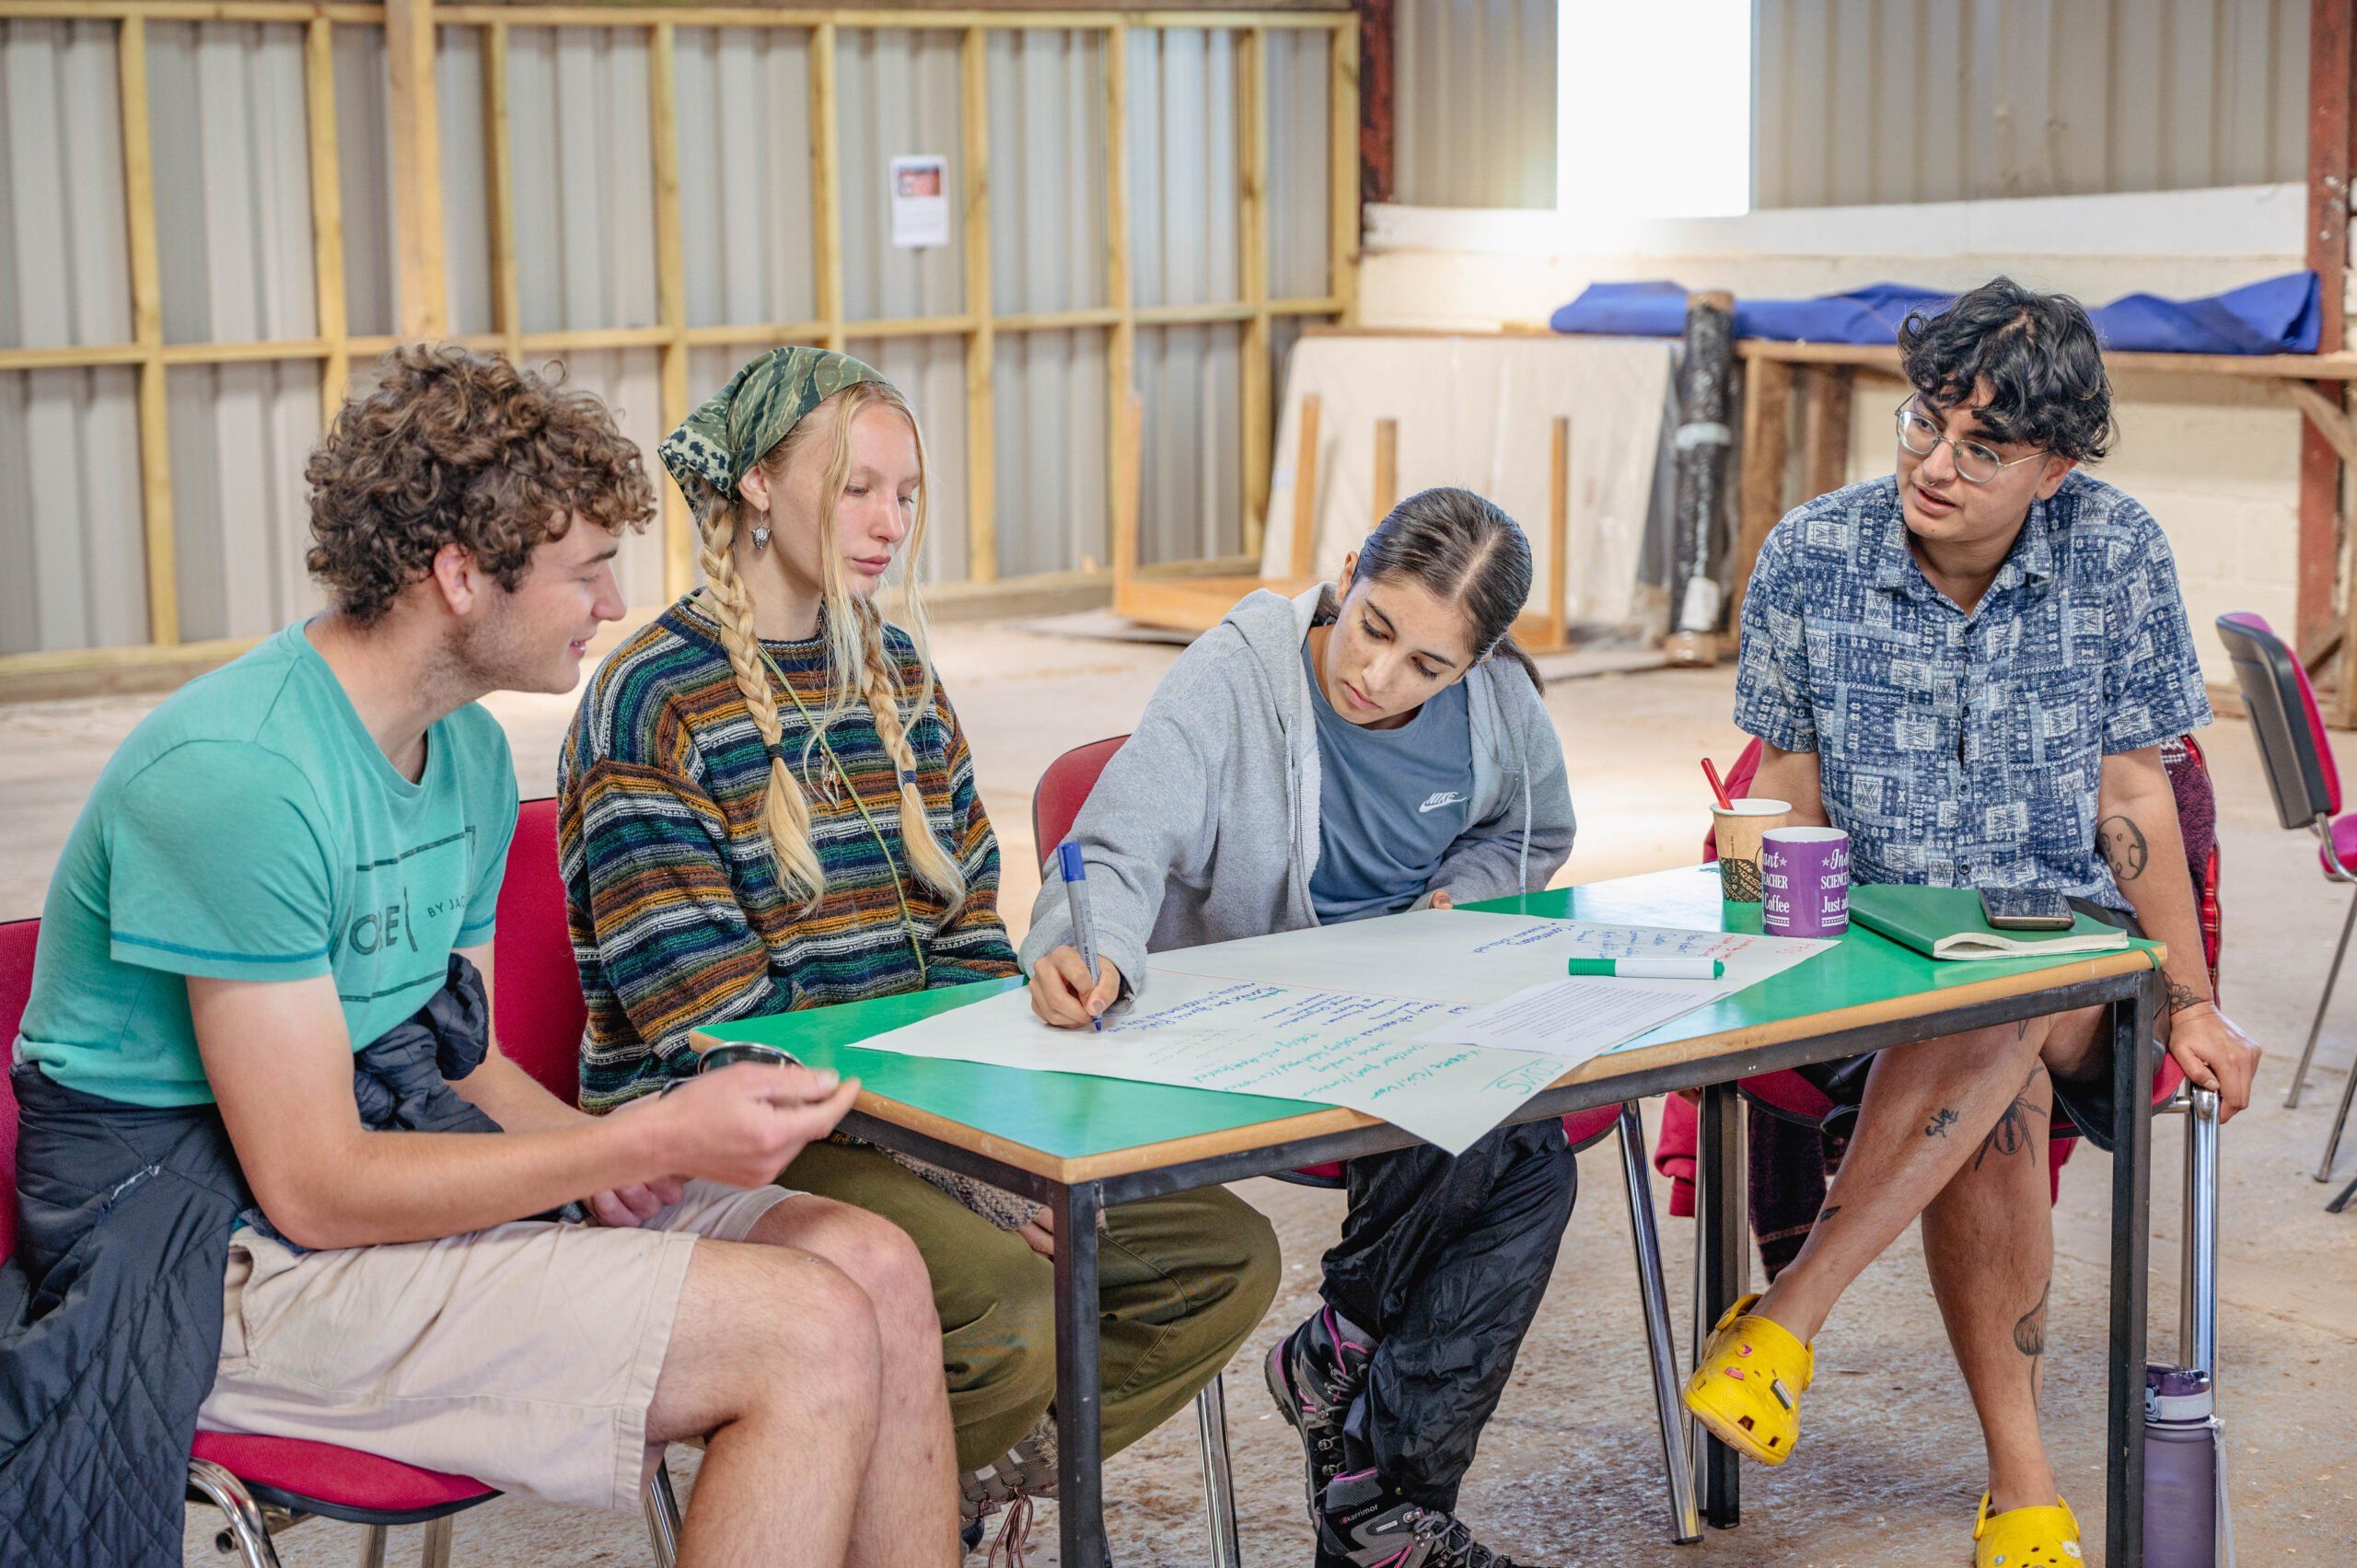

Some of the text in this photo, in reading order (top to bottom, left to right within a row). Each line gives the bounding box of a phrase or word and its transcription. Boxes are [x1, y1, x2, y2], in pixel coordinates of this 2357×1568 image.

[1426, 791, 1459, 805] NIKE
[426, 902, 444, 918] BY
[1764, 892, 1790, 913] Coffee
[1822, 895, 1840, 913] Just
[1347, 1504, 1378, 1522] karrimor
